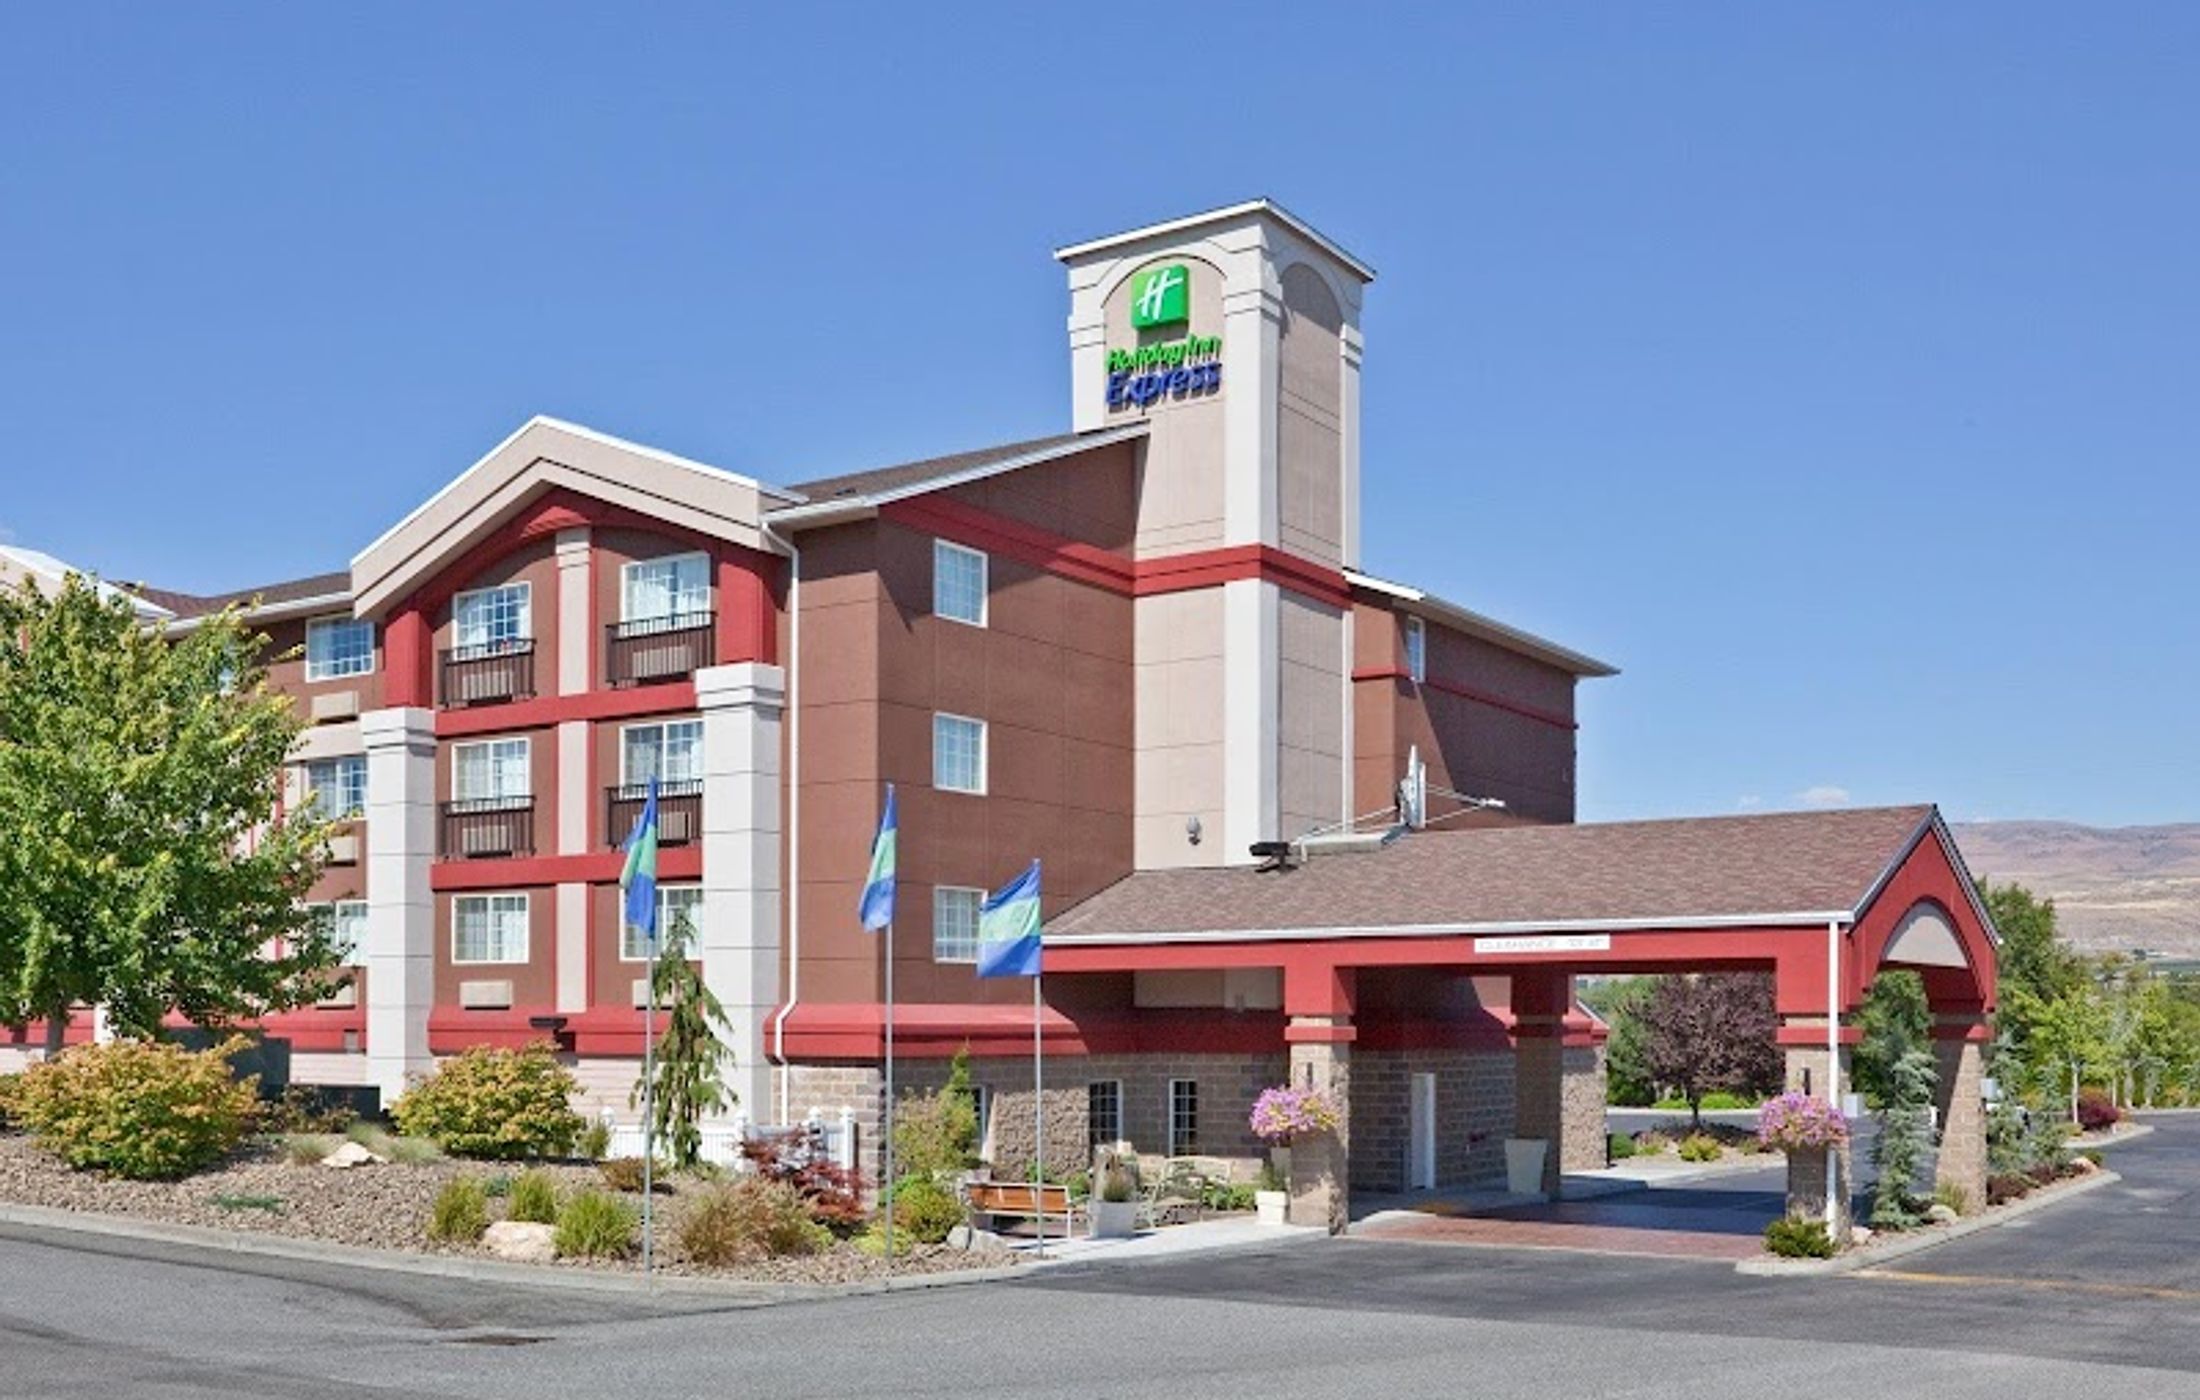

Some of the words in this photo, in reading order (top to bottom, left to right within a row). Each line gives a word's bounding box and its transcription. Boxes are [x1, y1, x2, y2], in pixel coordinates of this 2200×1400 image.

[1106, 341, 1184, 372] Holiday
[1186, 334, 1222, 361] Inn
[1106, 362, 1222, 409] Express
